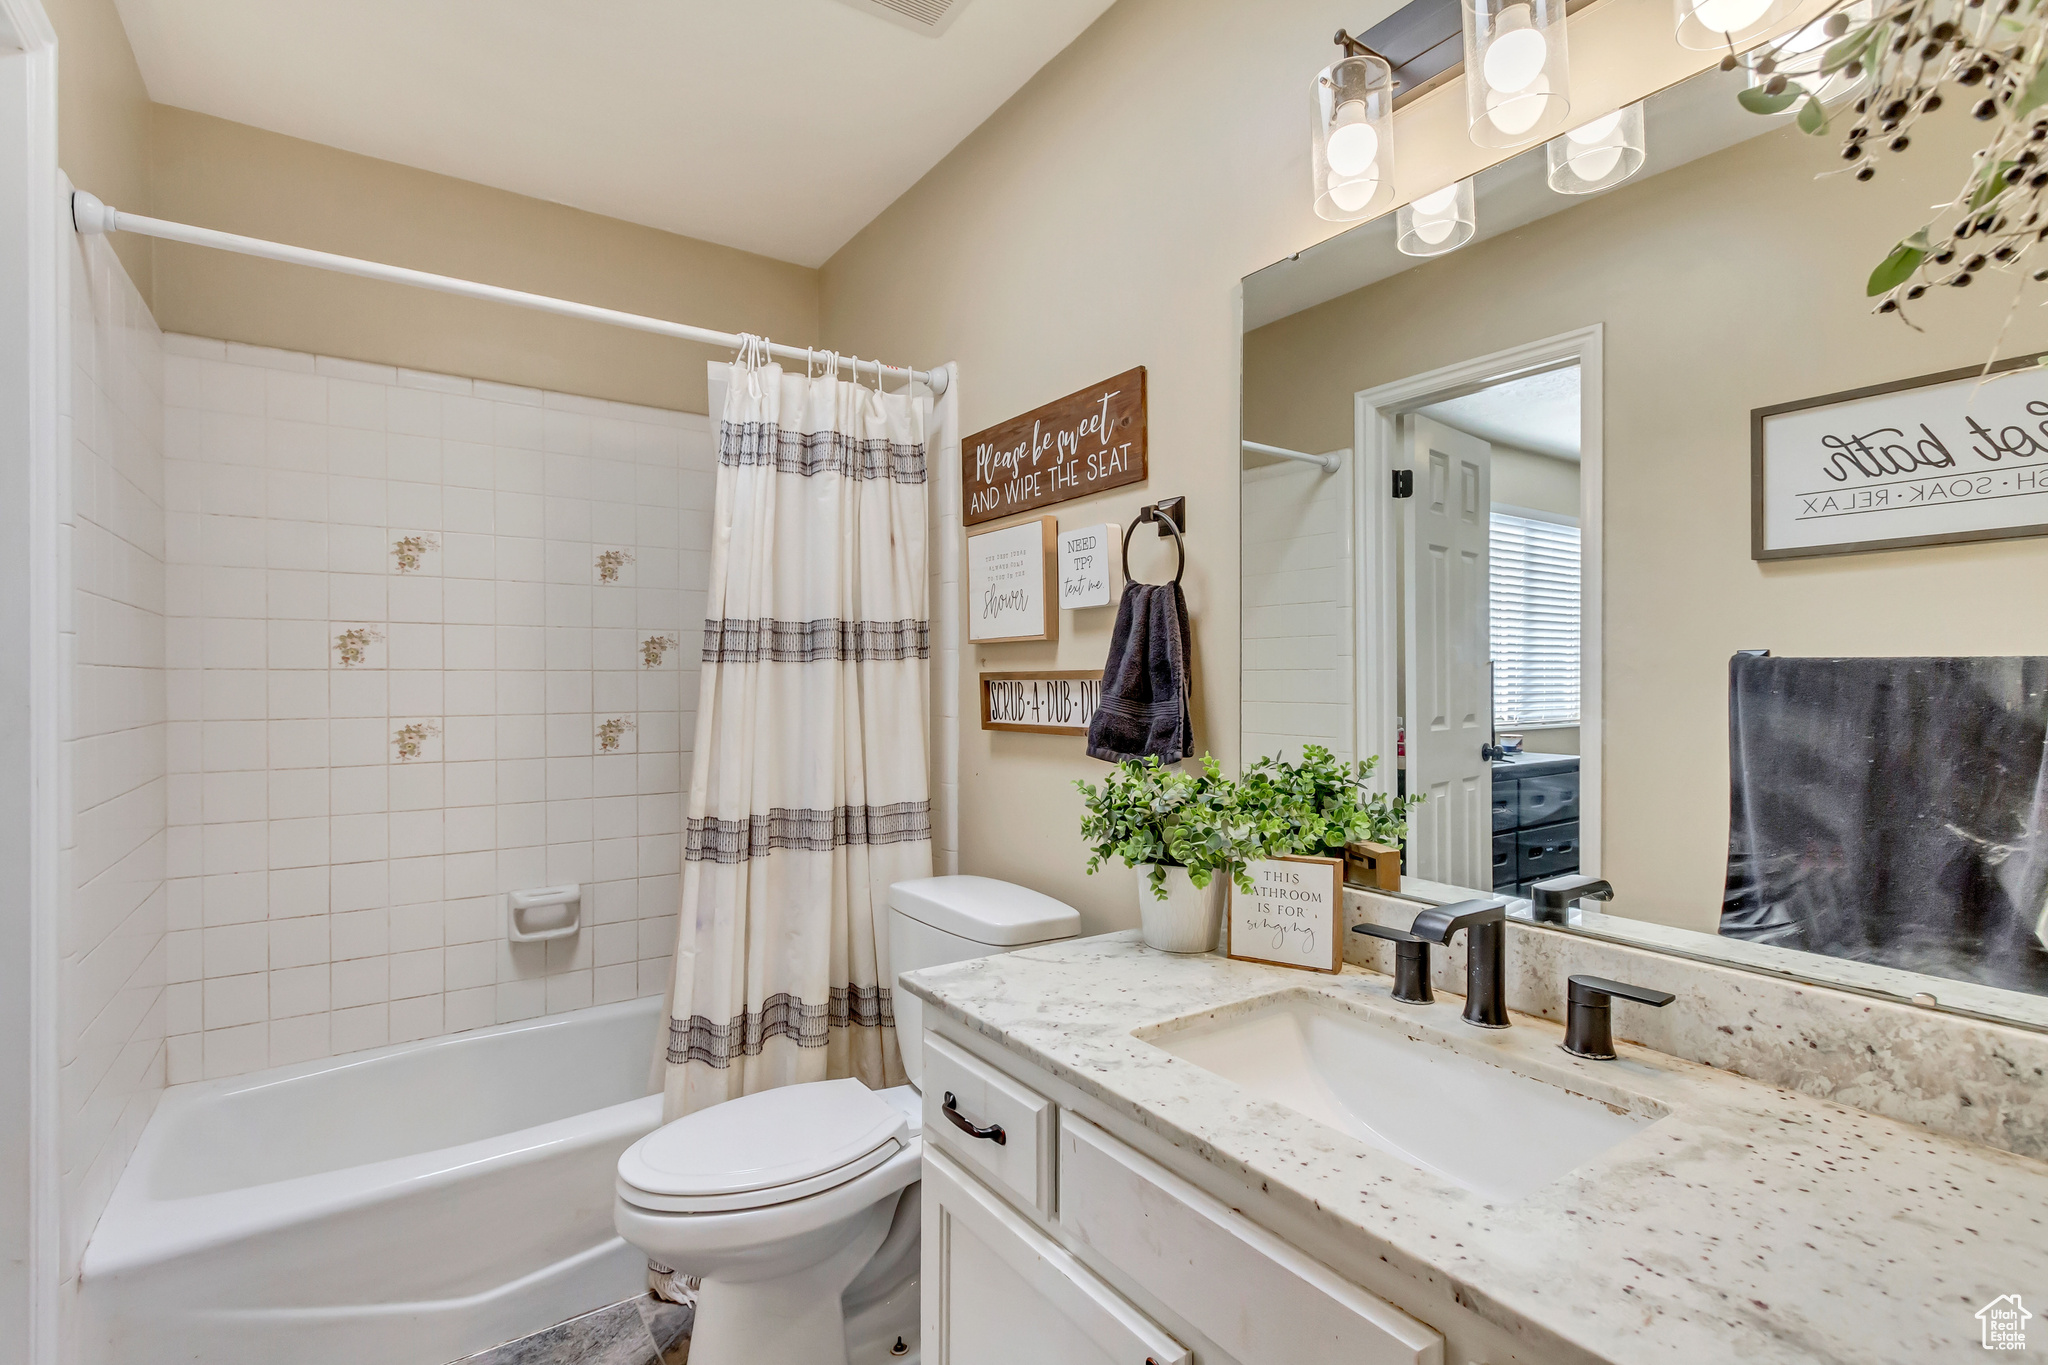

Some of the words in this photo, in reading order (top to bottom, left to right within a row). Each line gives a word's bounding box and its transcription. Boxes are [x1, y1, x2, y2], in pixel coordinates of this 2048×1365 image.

[976, 443, 1029, 485] Please
[1032, 419, 1054, 466] be
[1056, 390, 1121, 464] sweet
[970, 486, 1000, 516] AND
[1004, 471, 1041, 504] WIPE
[1047, 459, 1079, 492] THE
[1087, 442, 1132, 481] SEAT
[1067, 535, 1097, 554] NEED
[1073, 554, 1093, 571] TP?
[1063, 574, 1087, 598] text
[1080, 680, 1102, 724] DU
[1263, 870, 1300, 884] THIS
[1250, 885, 1322, 903] ATHROOM
[1257, 902, 1270, 914] IS
[1277, 904, 1305, 918] FOR
[1246, 918, 1316, 954] singing
